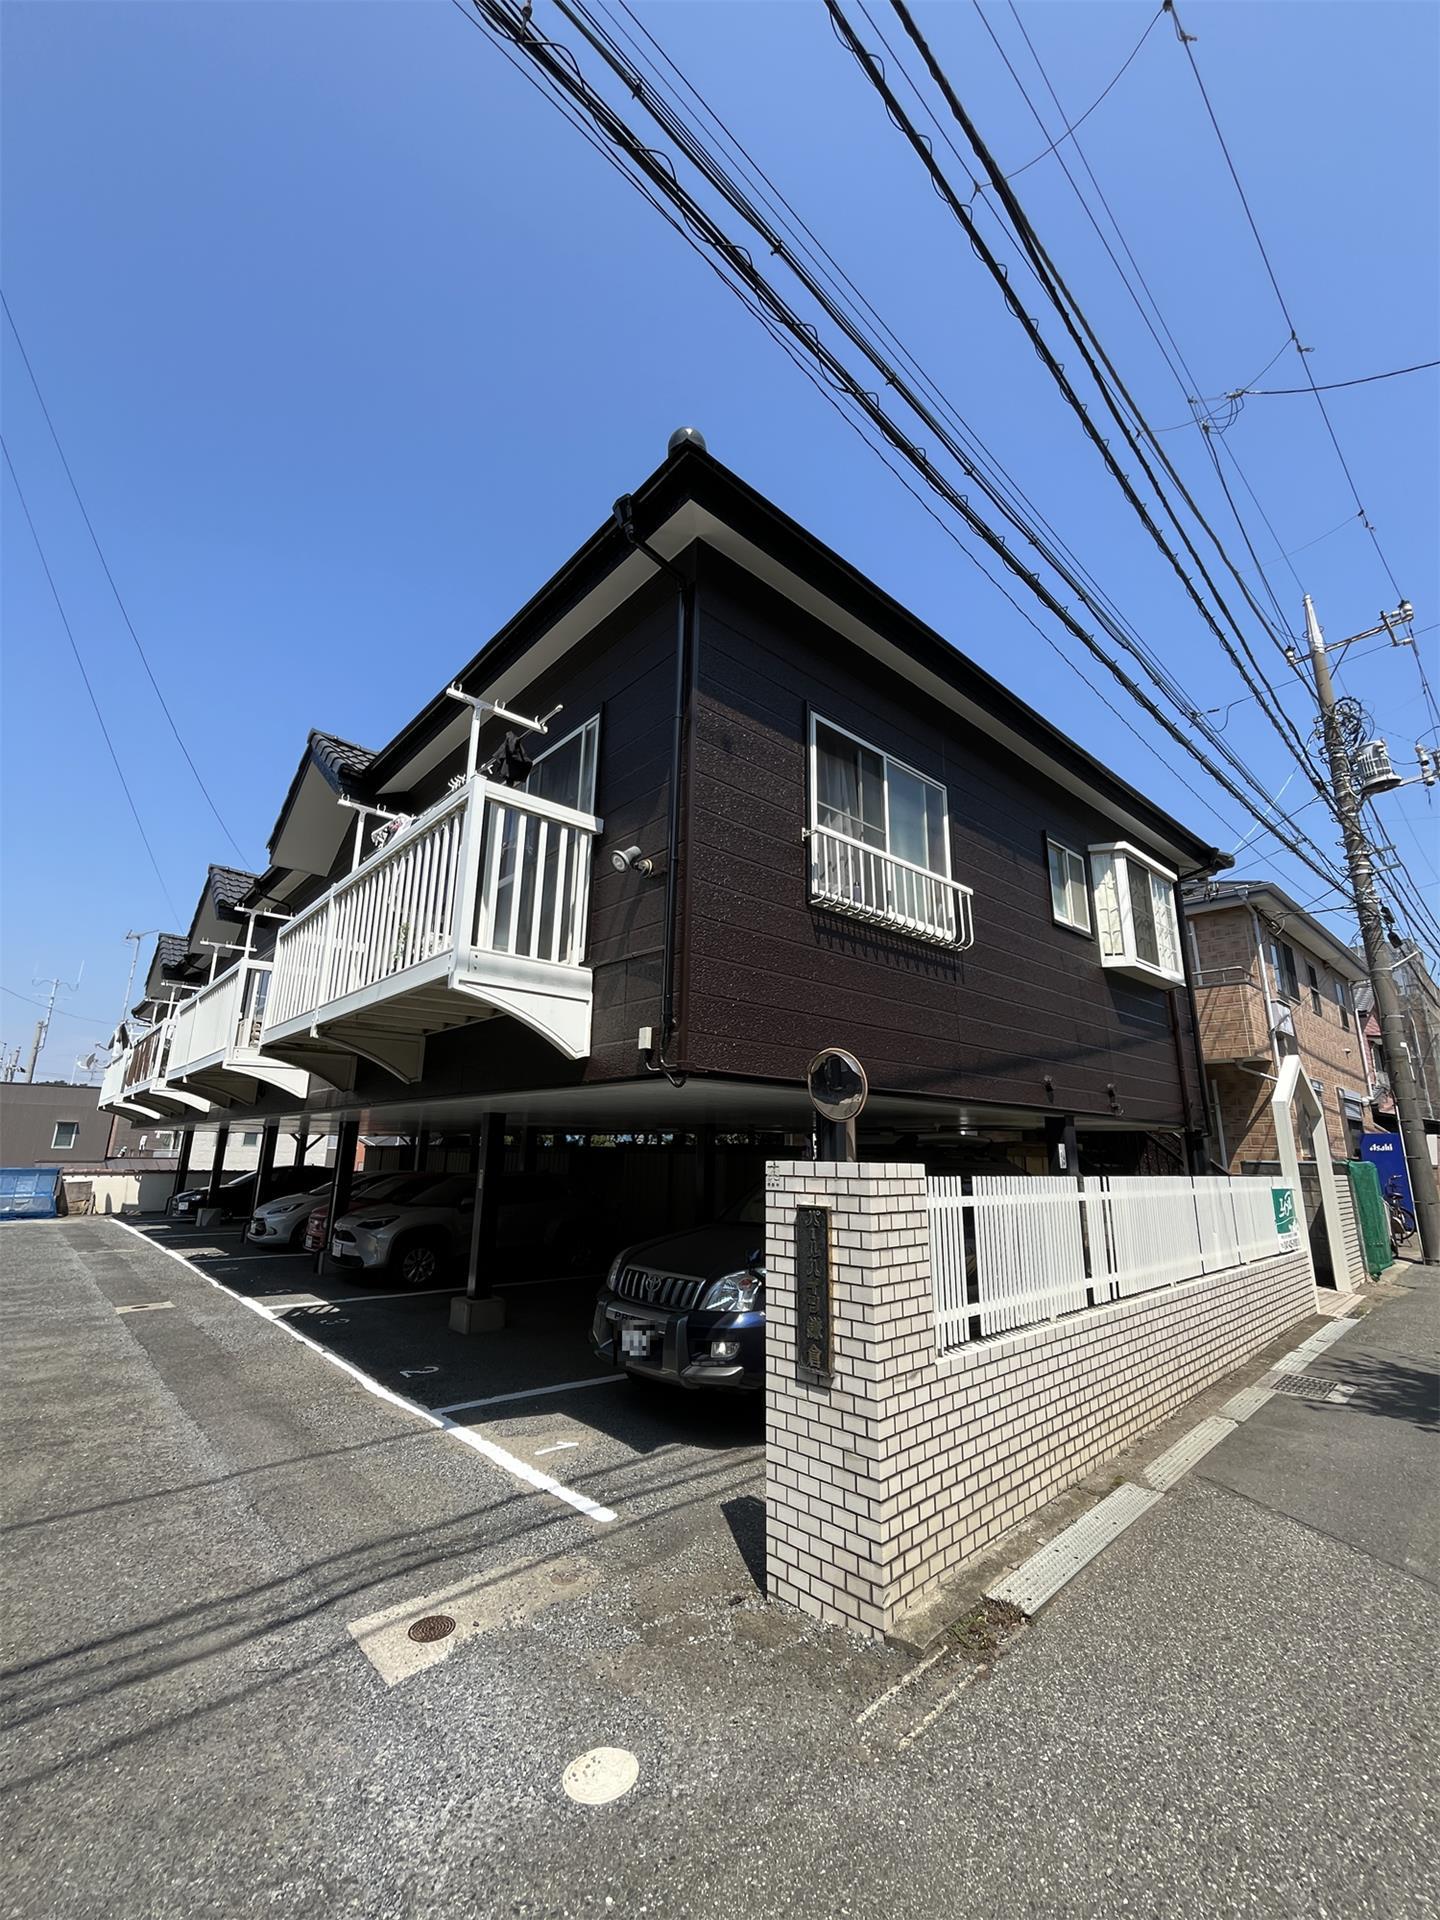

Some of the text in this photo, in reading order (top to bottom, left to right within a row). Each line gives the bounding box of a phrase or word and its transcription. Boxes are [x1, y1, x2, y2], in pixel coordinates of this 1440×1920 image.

[1369, 1143, 1393, 1151] Asahi
[399, 1366, 440, 1379] 2
[534, 1440, 580, 1455] 1
